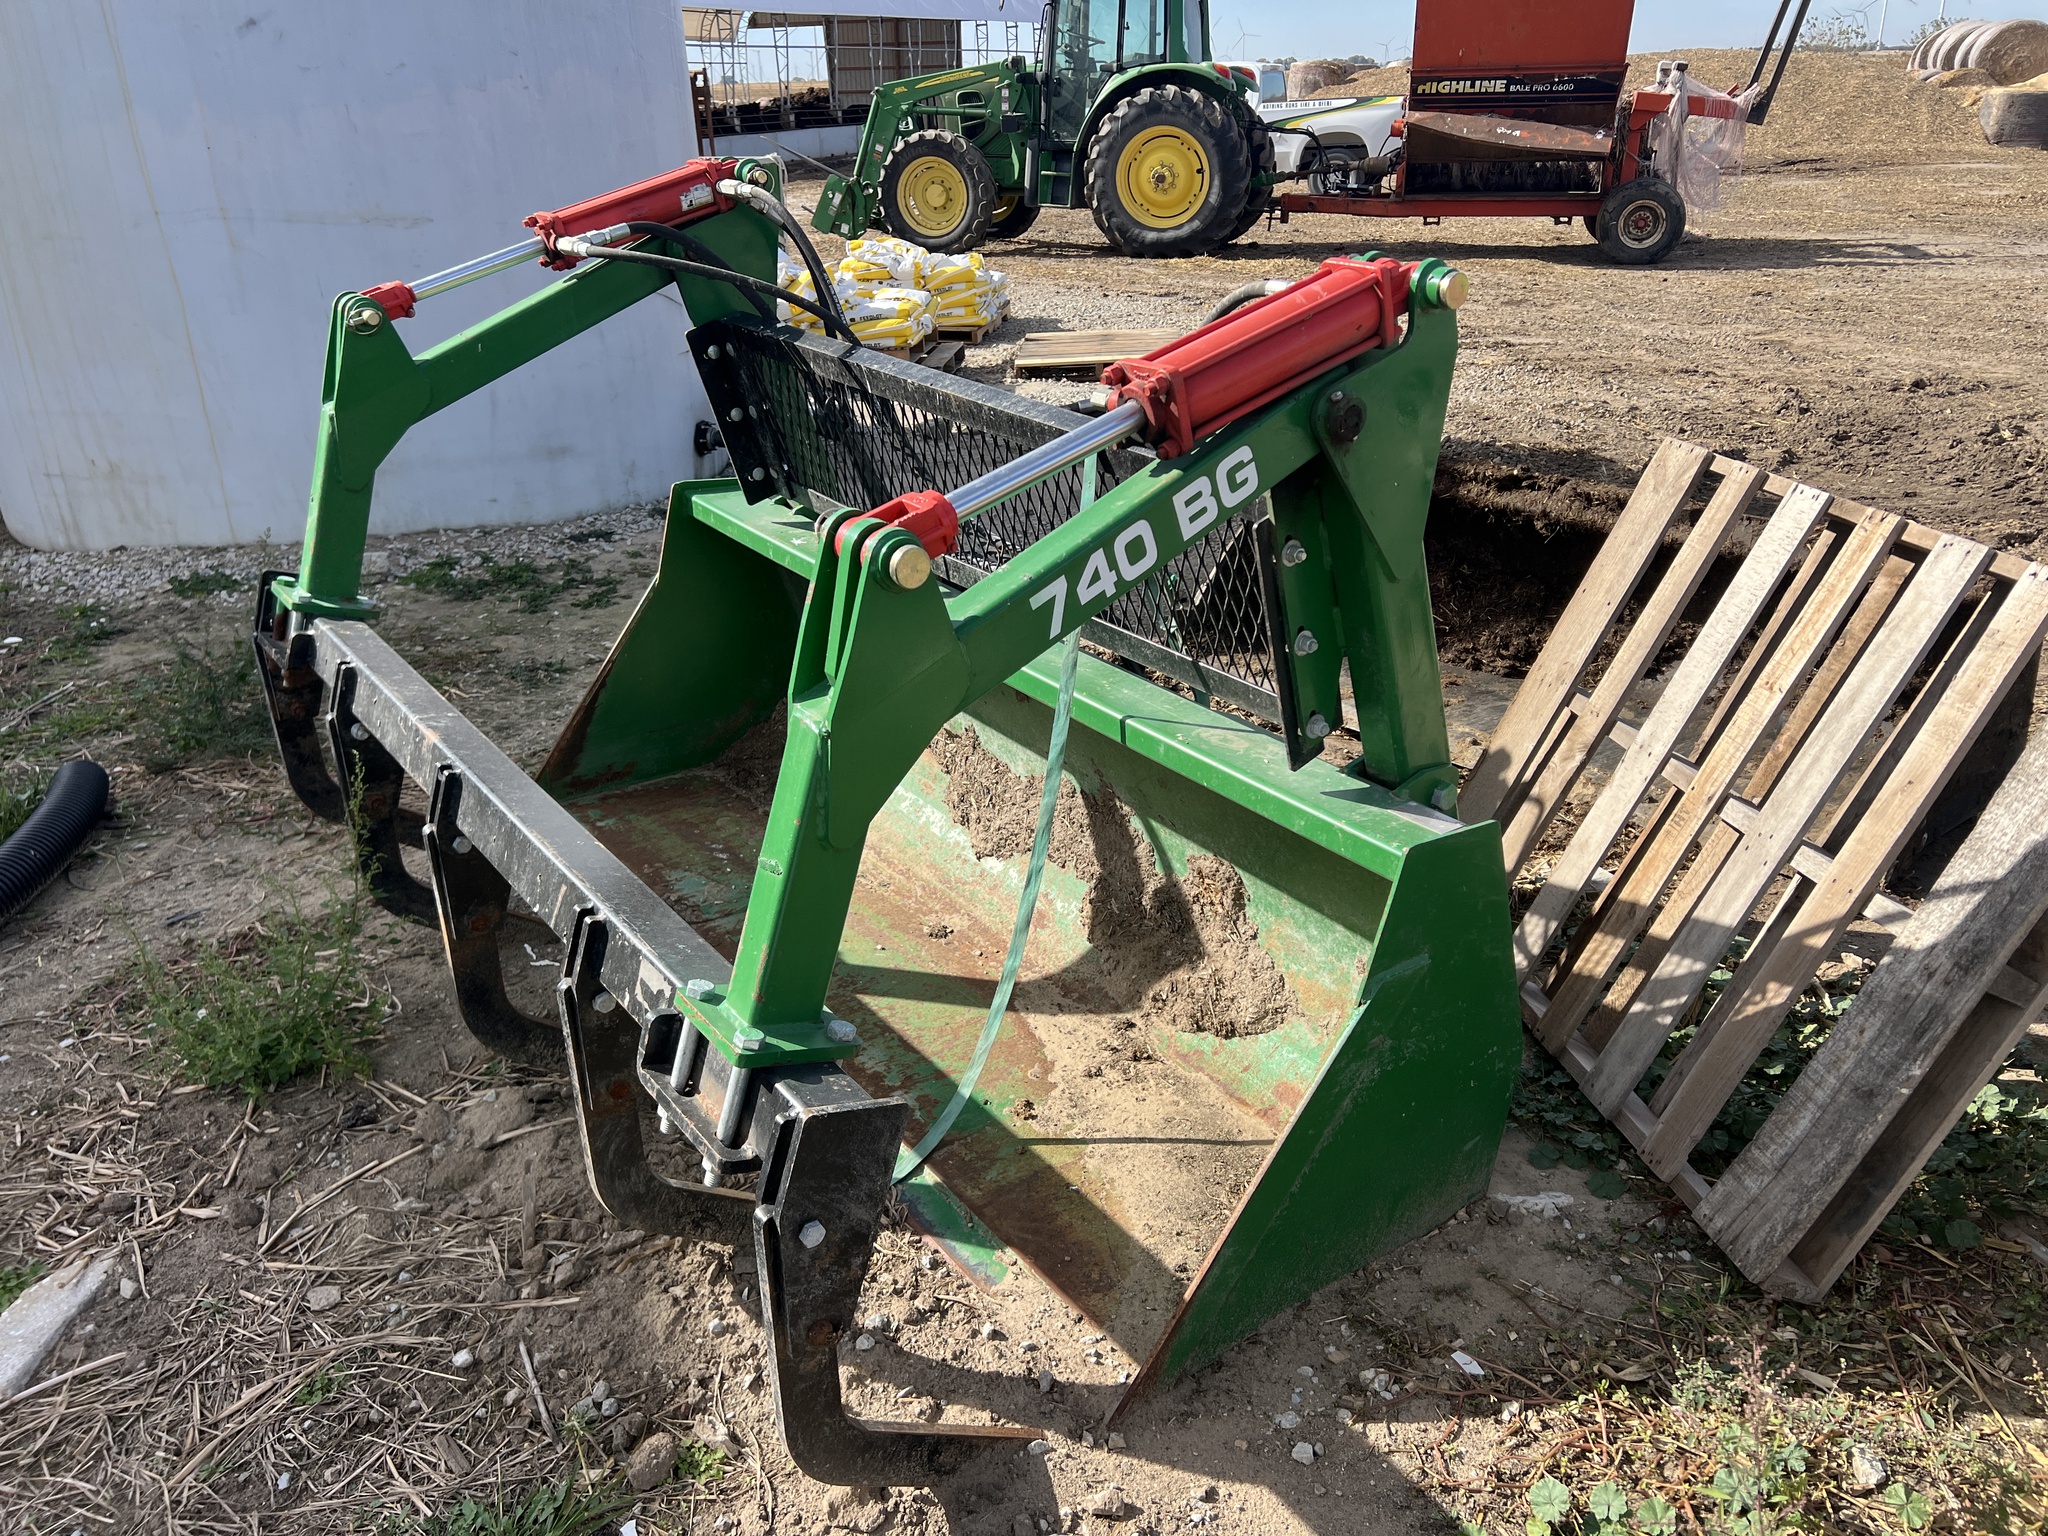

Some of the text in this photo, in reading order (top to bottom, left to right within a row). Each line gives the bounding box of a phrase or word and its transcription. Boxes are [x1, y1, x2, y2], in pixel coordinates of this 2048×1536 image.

[1417, 80, 1574, 94] HIGHLINE BALE PRO 6600
[859, 313, 882, 321] FEEDLOT
[1029, 445, 1259, 640] 740 BG
